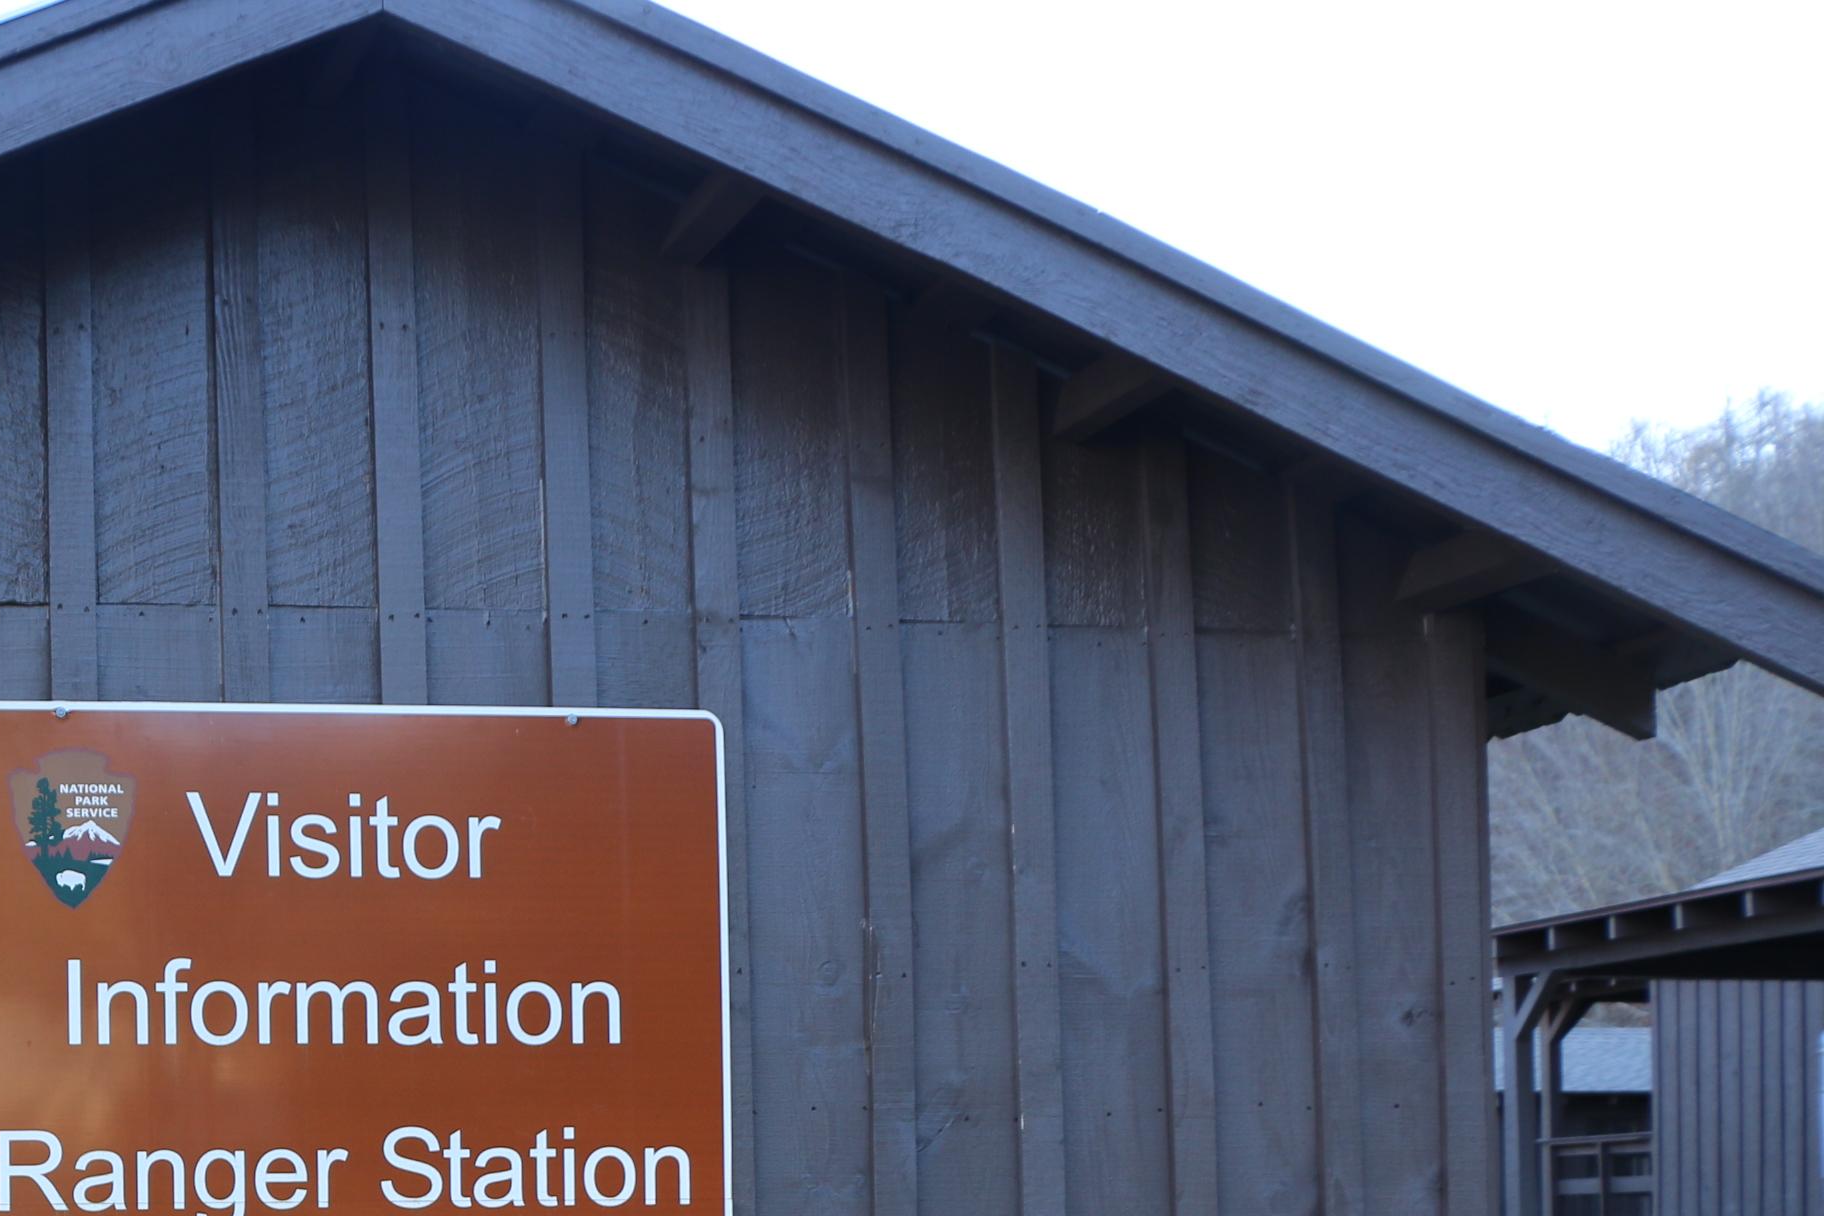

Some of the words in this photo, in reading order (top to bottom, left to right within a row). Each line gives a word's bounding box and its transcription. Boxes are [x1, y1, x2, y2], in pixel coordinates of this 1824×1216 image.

[59, 783, 124, 794] NATIONAL
[66, 807, 118, 818] SERVICE
[75, 795, 108, 806] PARK
[184, 790, 502, 880] Visitor
[66, 956, 622, 1048] Information
[379, 1125, 691, 1210] Station
